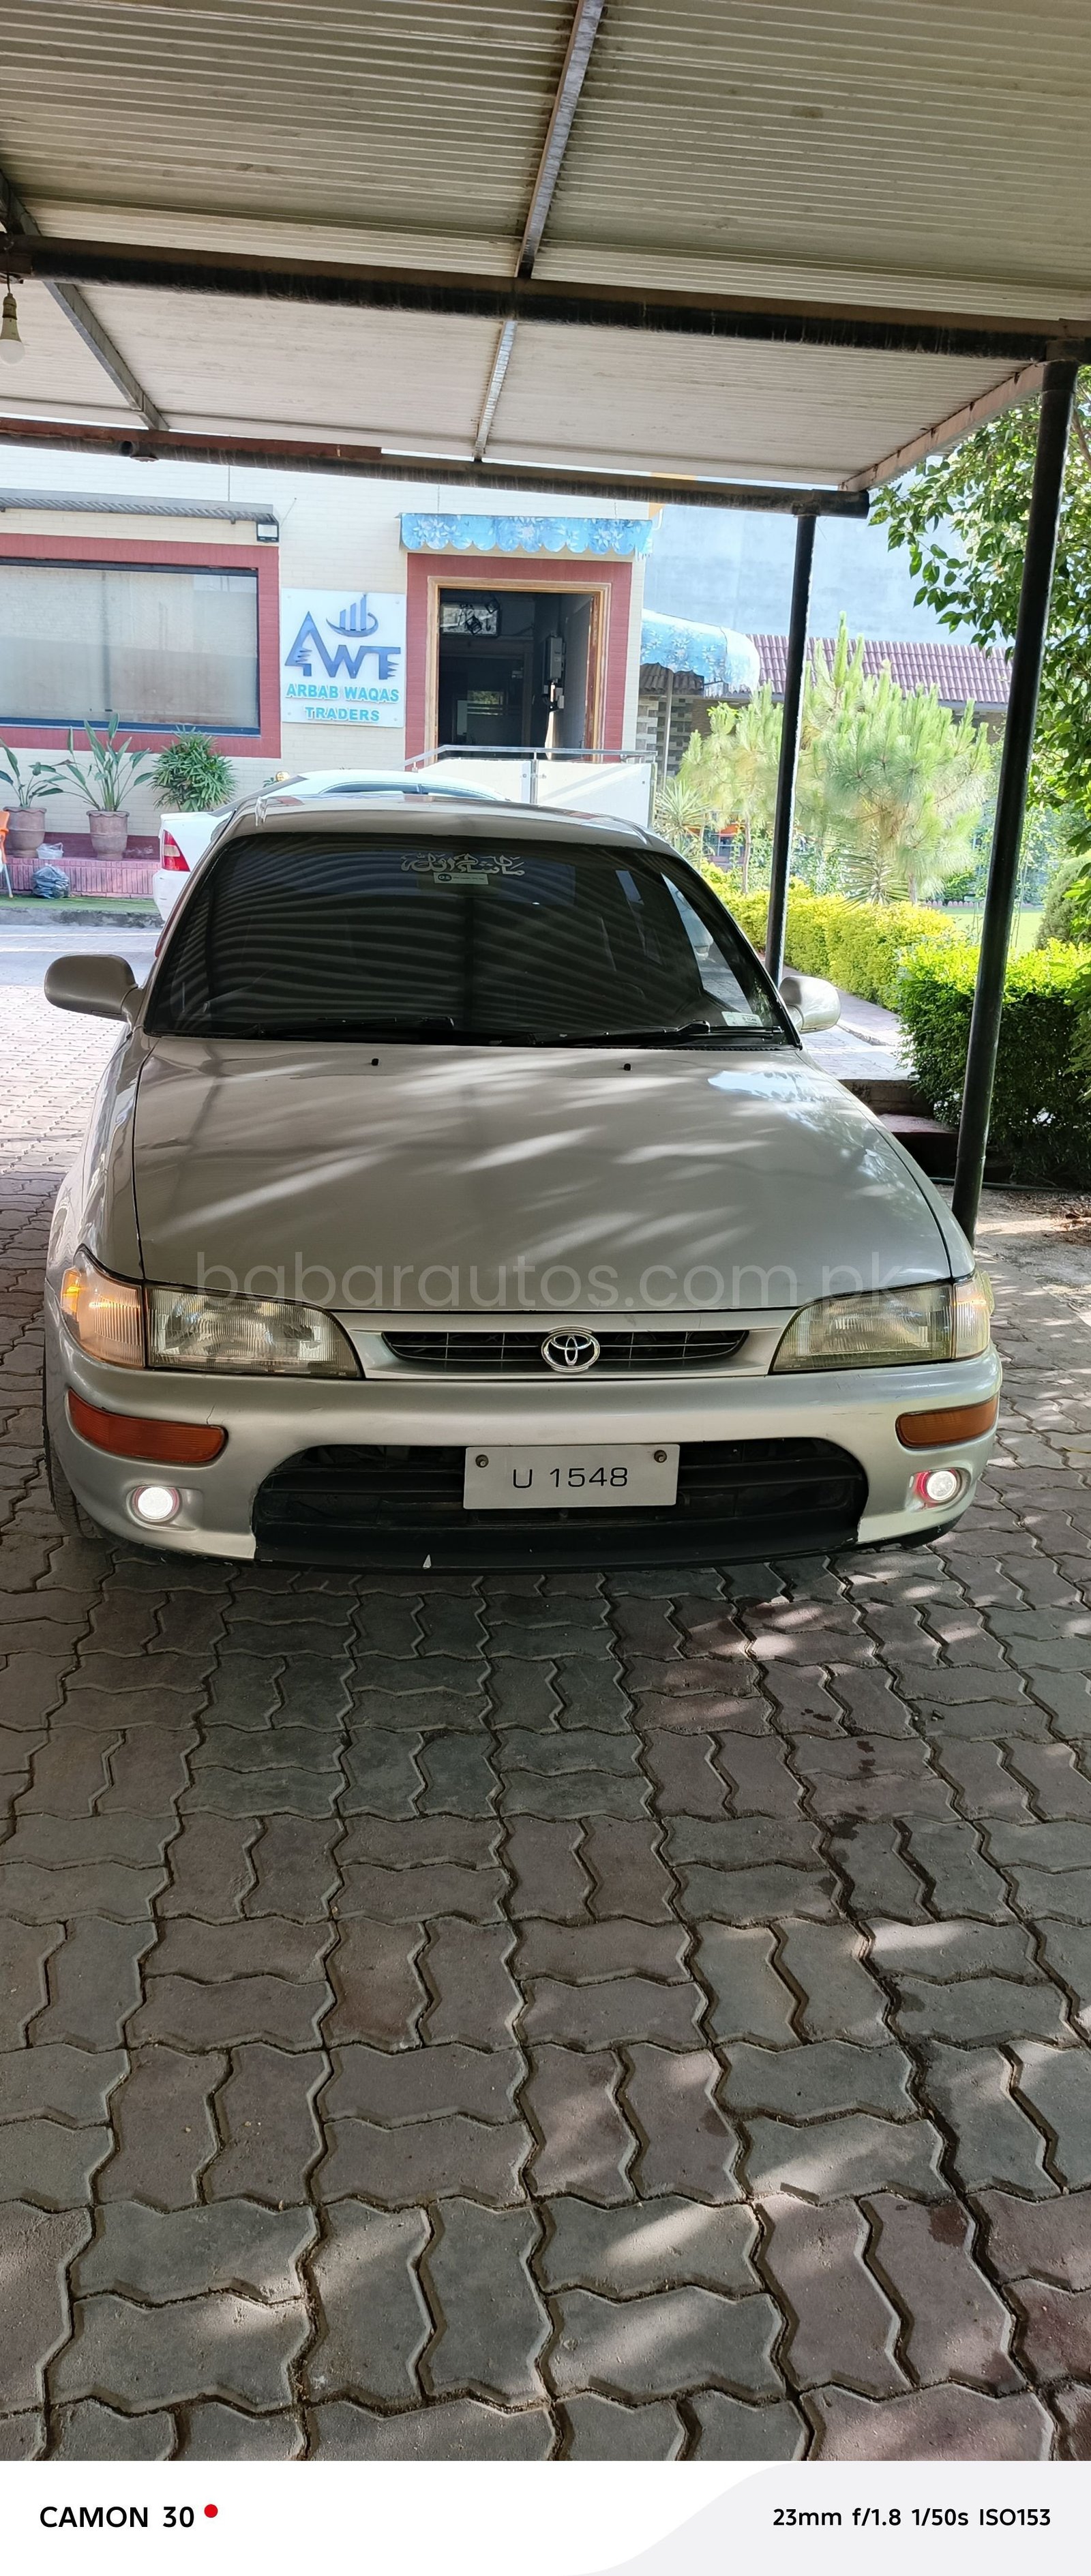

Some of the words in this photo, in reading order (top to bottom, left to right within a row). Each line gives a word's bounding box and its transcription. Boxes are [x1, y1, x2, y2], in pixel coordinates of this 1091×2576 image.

[284, 611, 401, 680] AWT
[286, 683, 339, 699] ARBAB
[344, 686, 400, 702] WAQAS
[305, 706, 380, 722] TRADERS
[513, 1469, 533, 1489] U
[550, 1467, 628, 1488] 1548
